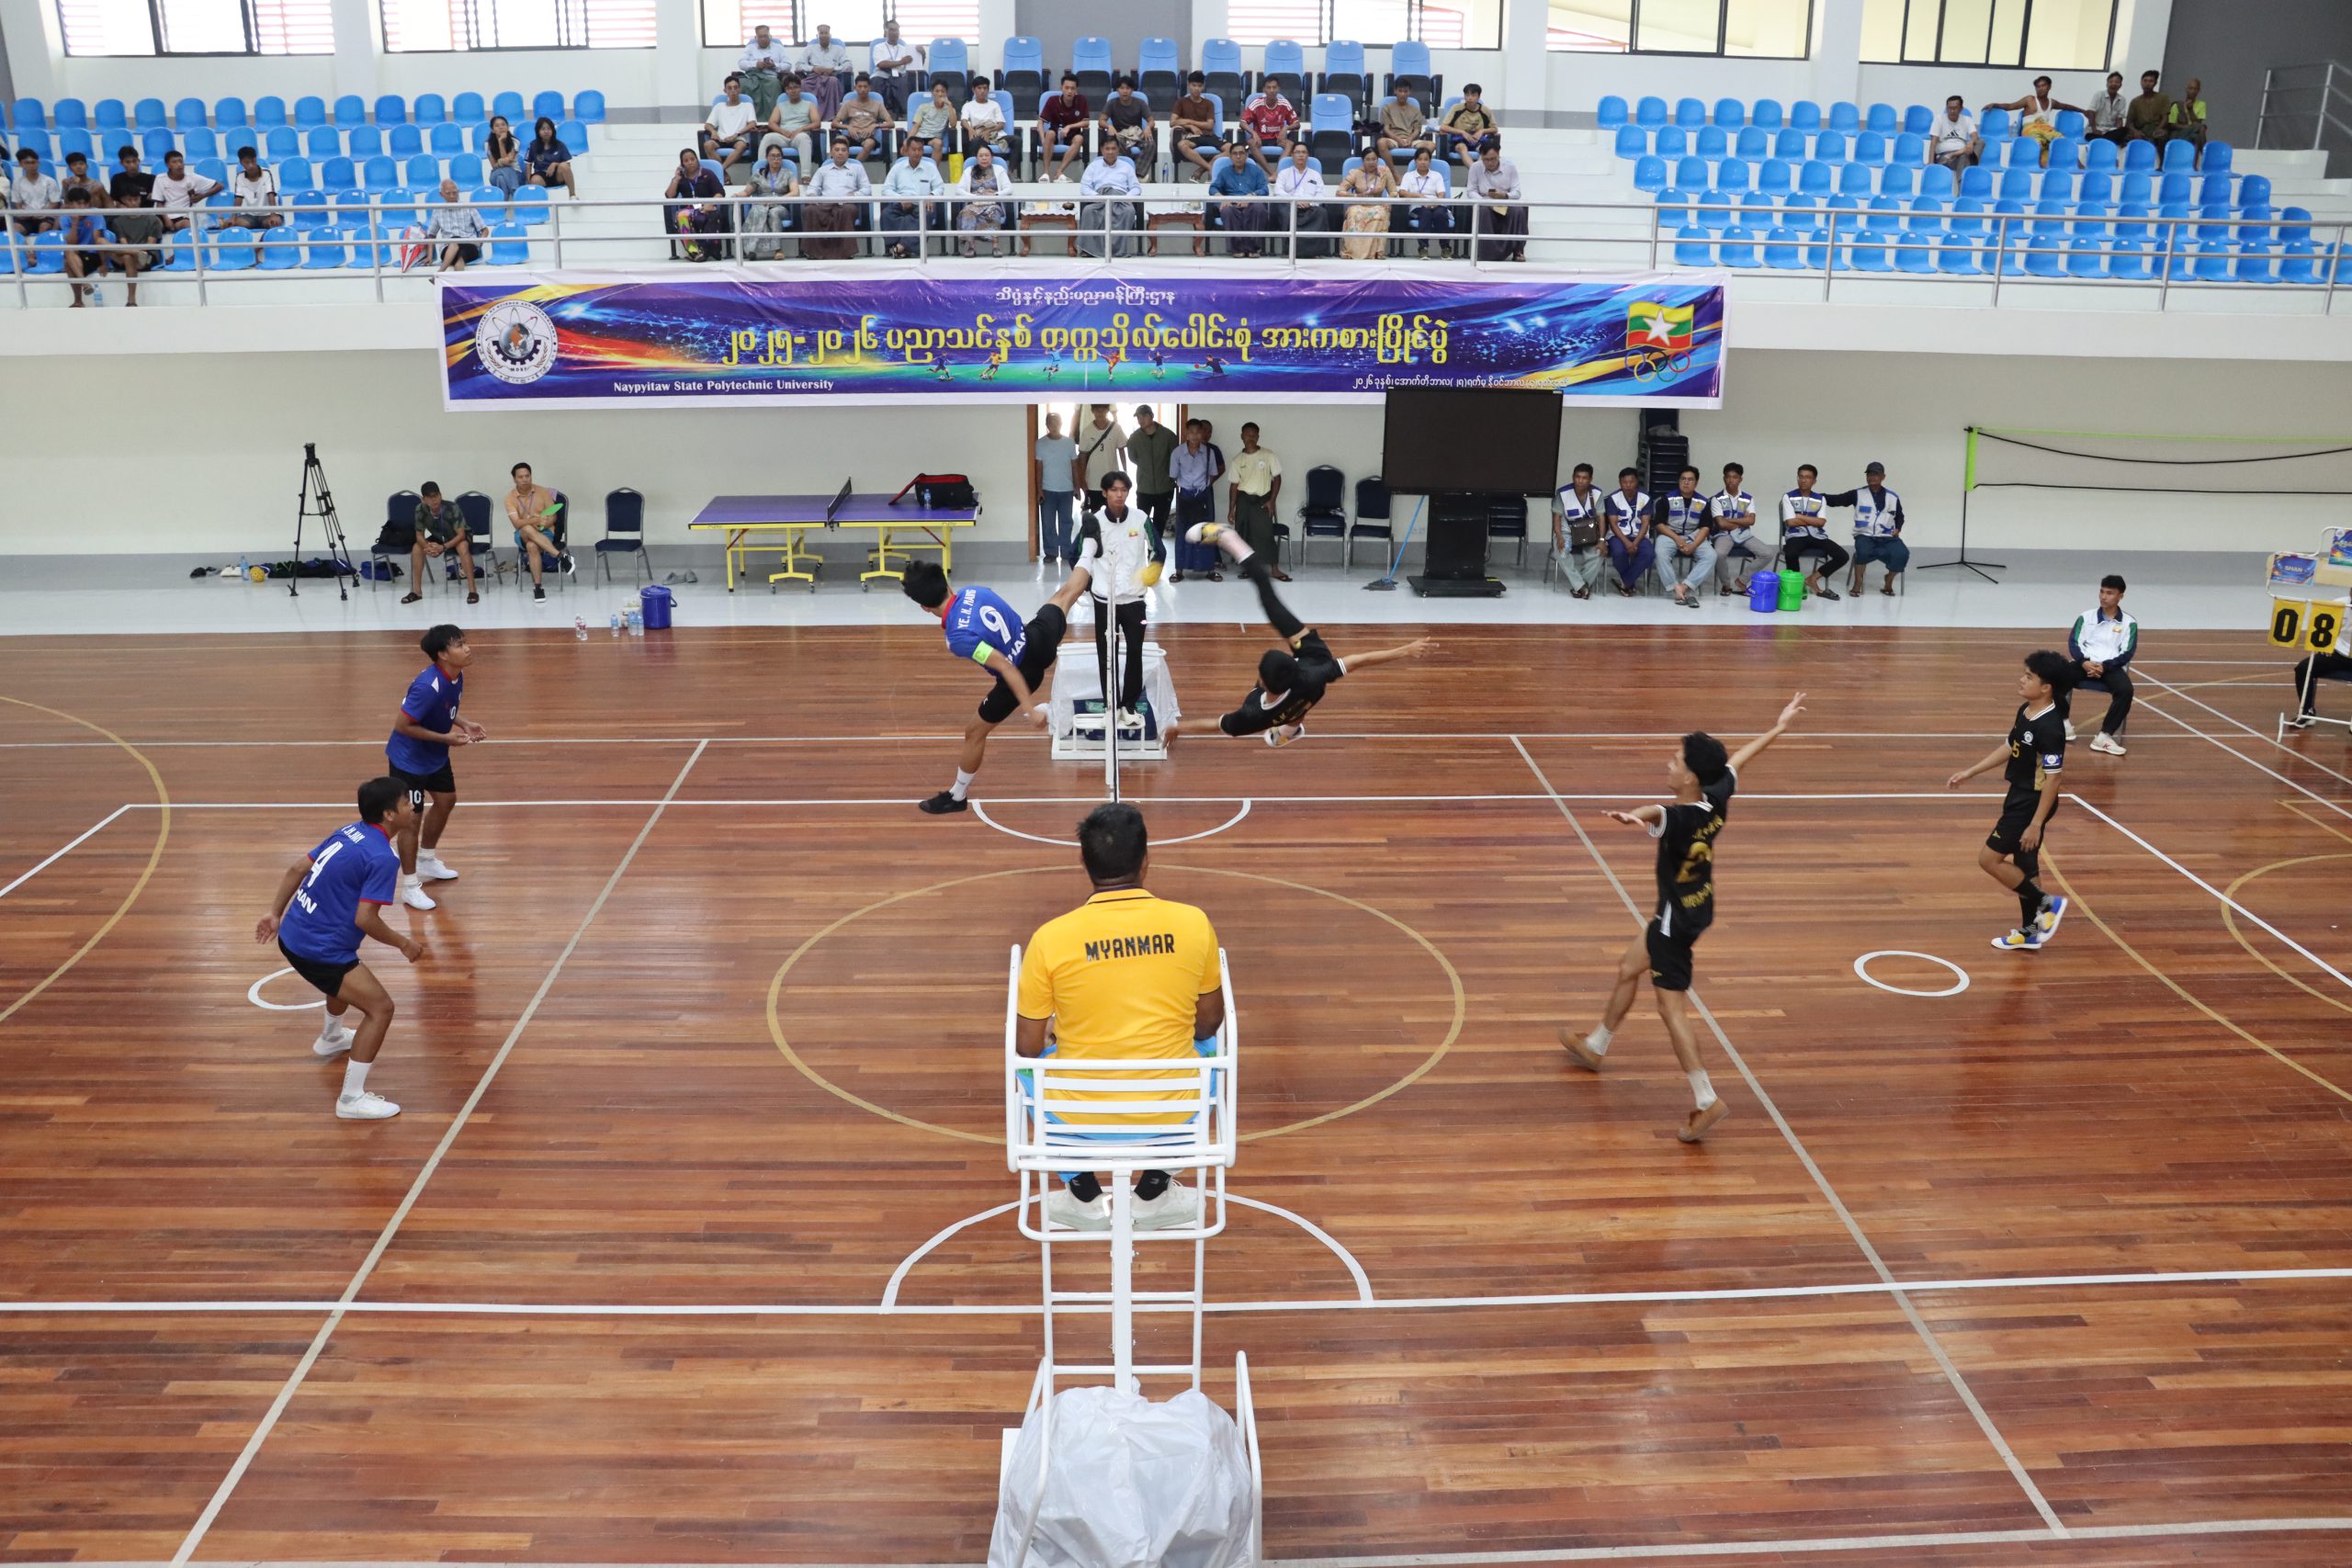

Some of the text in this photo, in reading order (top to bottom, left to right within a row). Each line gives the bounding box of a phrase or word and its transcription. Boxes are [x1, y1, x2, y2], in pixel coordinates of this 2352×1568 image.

[614, 379, 834, 394] Naypyitaw State Polytechnic University
[979, 605, 1011, 645] 9
[409, 790, 422, 805] 10
[307, 840, 344, 888] 4
[1085, 933, 1175, 962] MYANMAR
